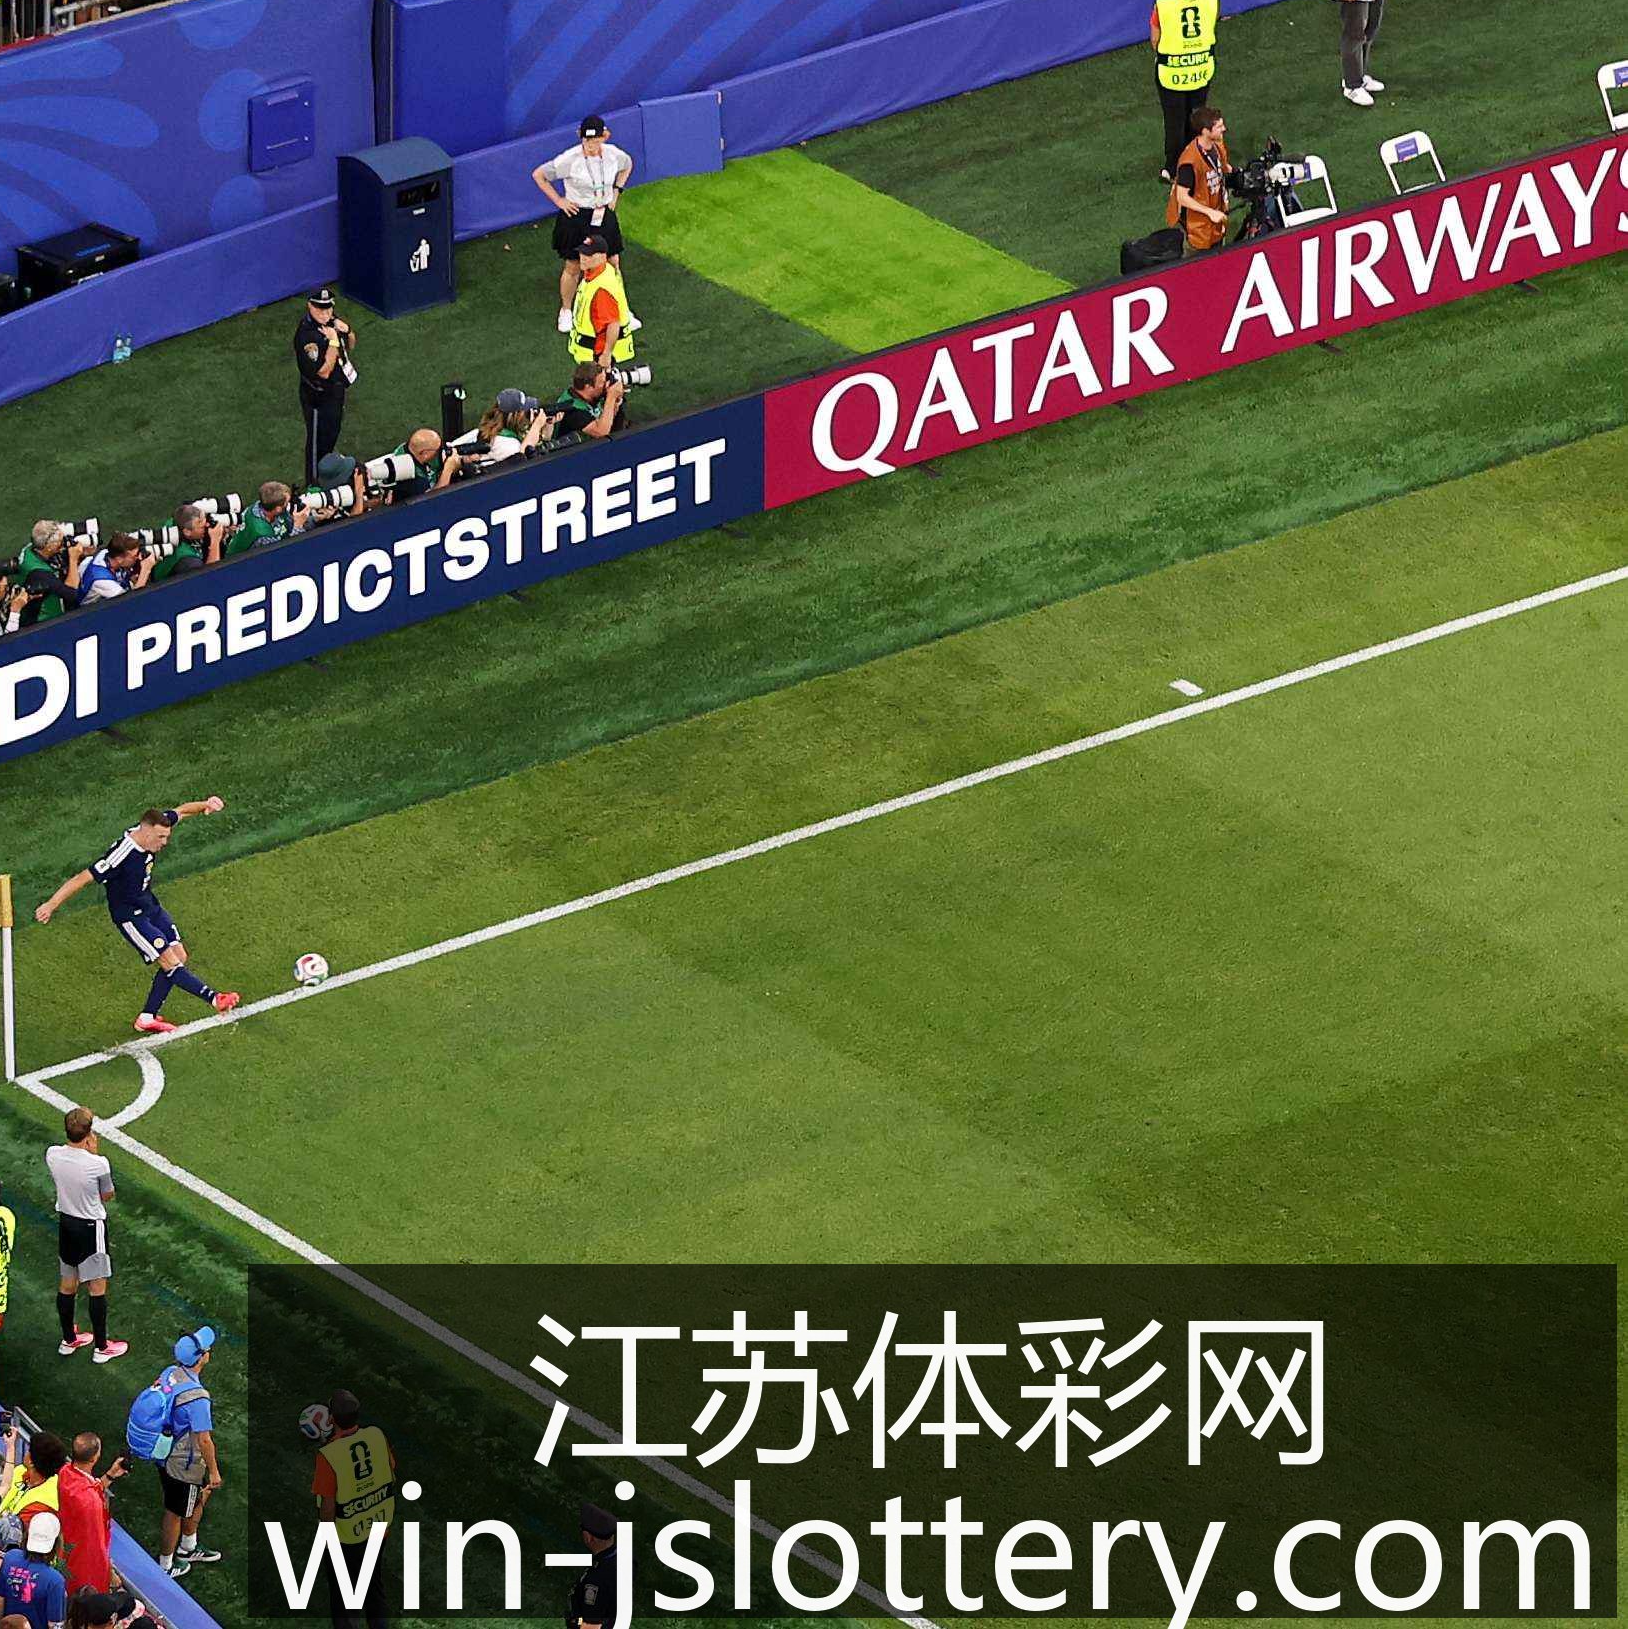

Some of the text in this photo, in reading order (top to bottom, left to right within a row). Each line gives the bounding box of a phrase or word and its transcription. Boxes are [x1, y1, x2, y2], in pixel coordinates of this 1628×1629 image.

[812, 148, 1628, 477] QATAR AIRWAY
[127, 438, 726, 690] PREDICTSTREET
